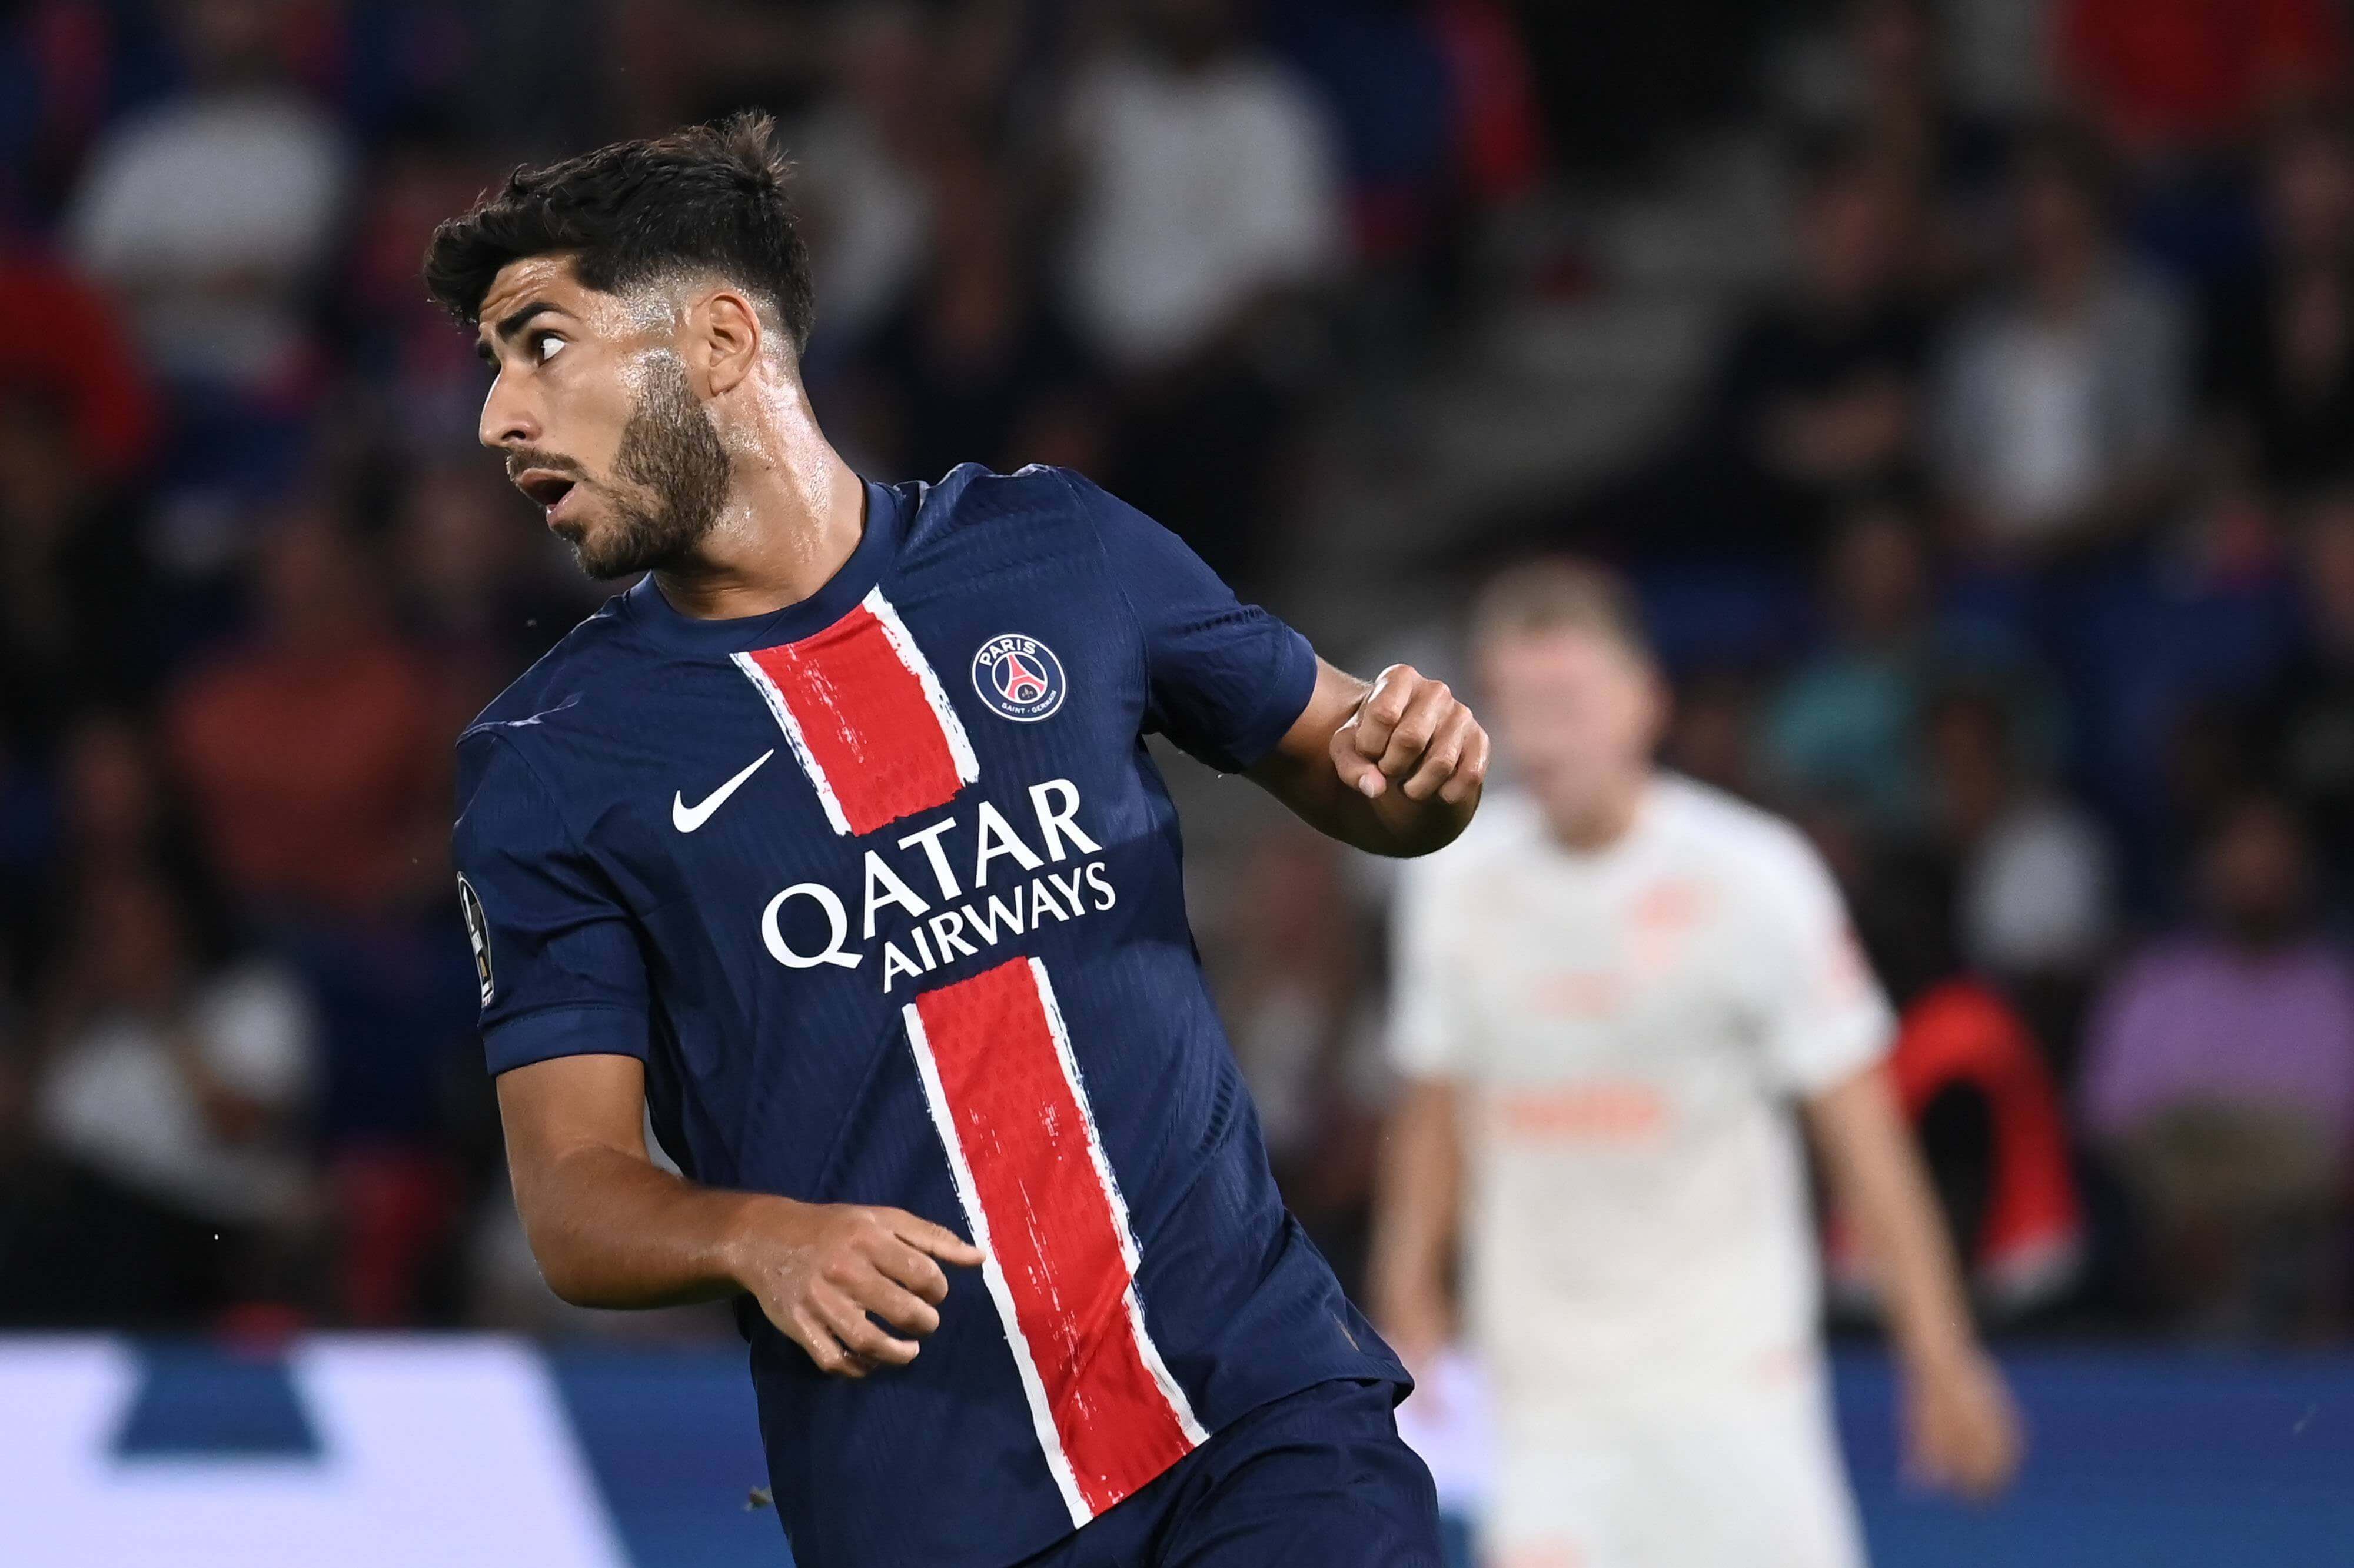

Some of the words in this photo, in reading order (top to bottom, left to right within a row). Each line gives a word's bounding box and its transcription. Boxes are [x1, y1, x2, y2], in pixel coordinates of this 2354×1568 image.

[979, 639, 1036, 666] PARIS
[1002, 703, 1026, 714] SAINT
[762, 778, 1102, 968] QATAR
[883, 862, 1116, 994] AIRWAYS
